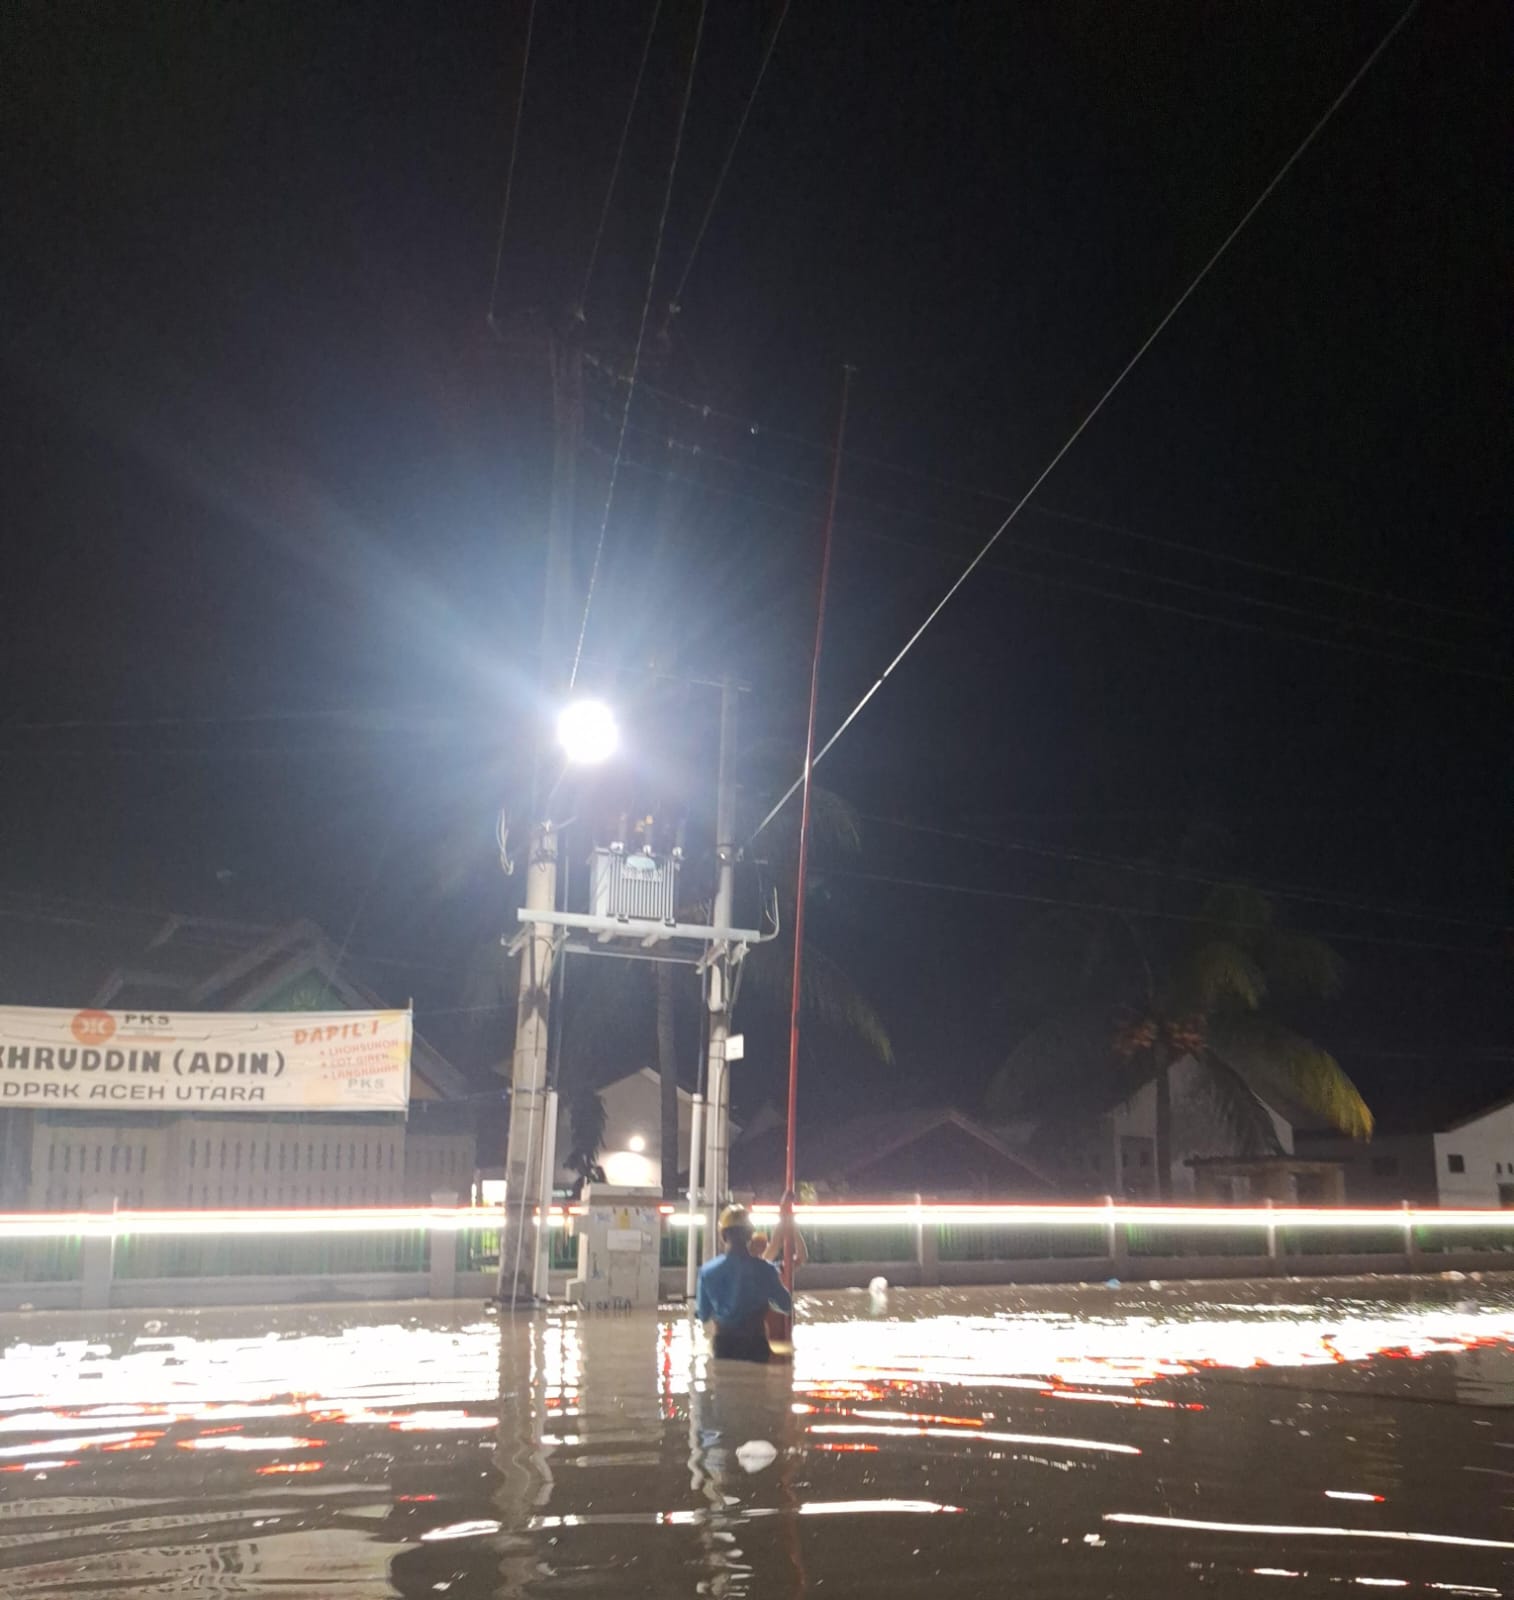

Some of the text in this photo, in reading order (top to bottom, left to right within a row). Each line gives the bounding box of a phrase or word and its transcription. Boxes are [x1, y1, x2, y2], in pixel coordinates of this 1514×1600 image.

[125, 1014, 170, 1026] PKS
[293, 1023, 362, 1044] DAPIL
[0, 1045, 286, 1078] HRUDDIN (ADIN)
[3, 1081, 266, 1101] DPRK ACEH UTARA
[347, 1078, 385, 1089] PKS
